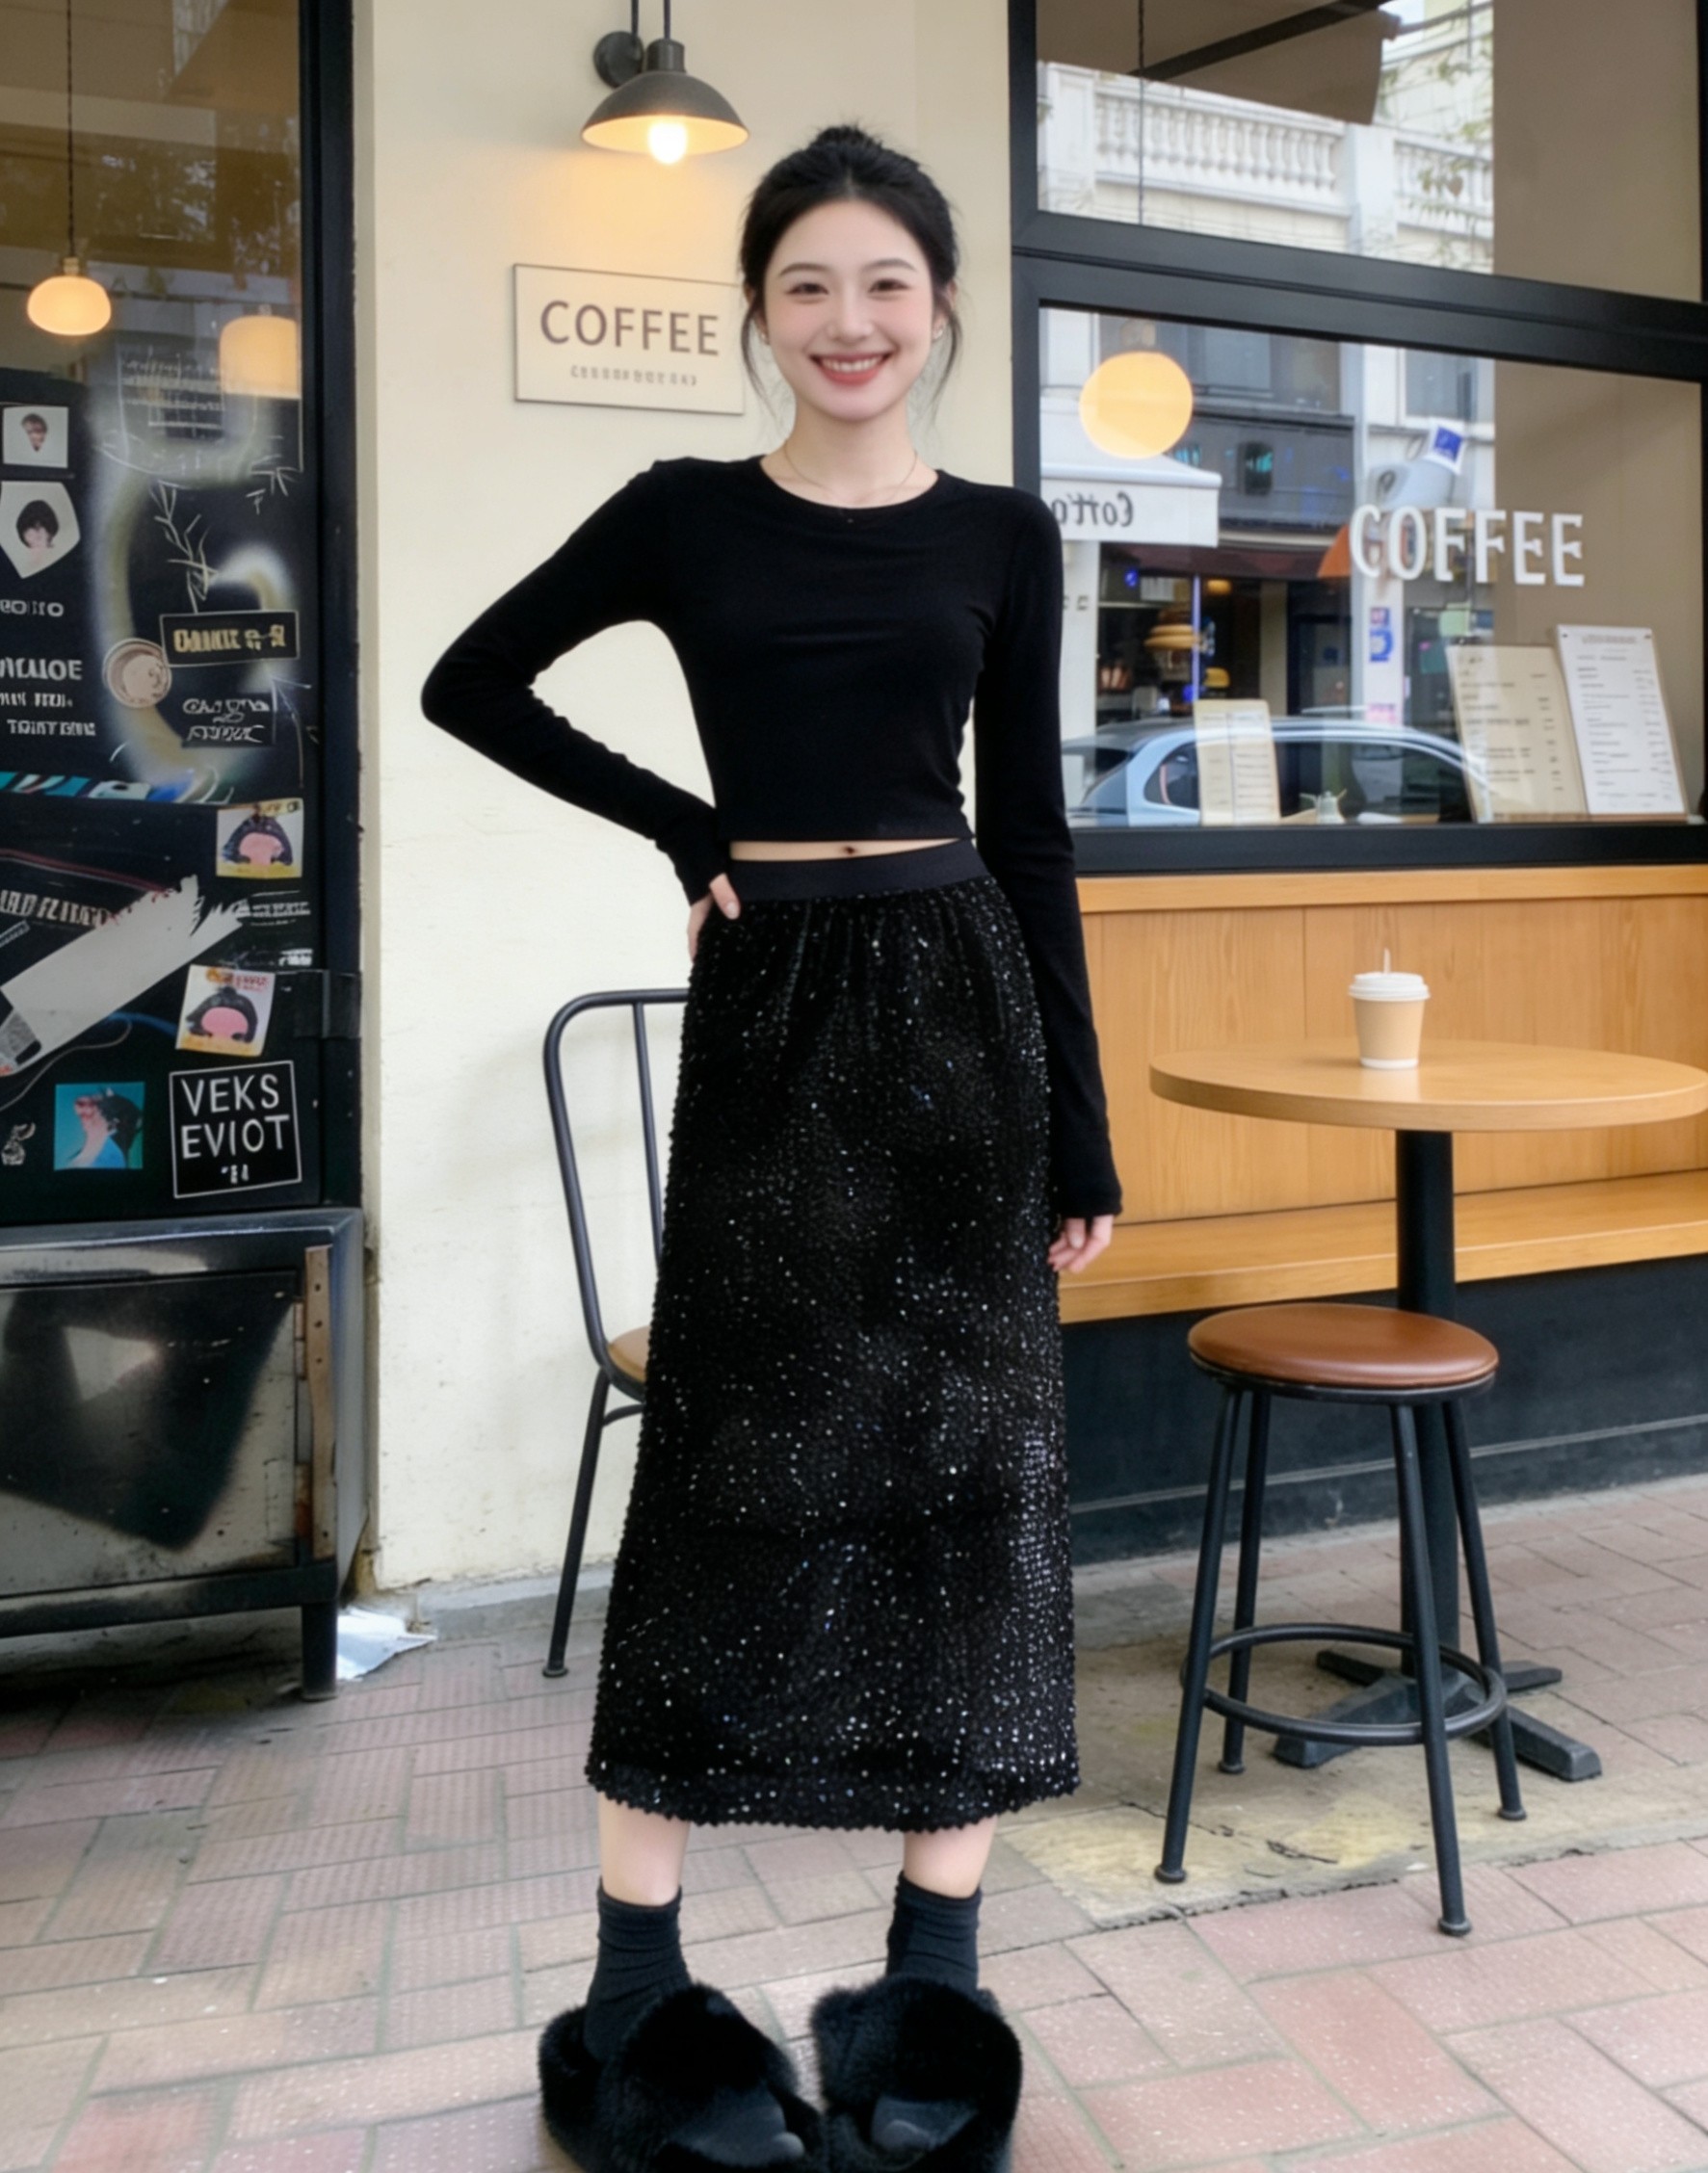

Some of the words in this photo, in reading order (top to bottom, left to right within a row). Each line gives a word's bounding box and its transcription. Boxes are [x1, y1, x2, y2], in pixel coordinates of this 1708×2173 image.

[540, 300, 719, 356] COFFEE
[1350, 504, 1586, 587] COFFEE
[180, 1073, 279, 1116] VEKS
[180, 1113, 290, 1160] EVIOT
